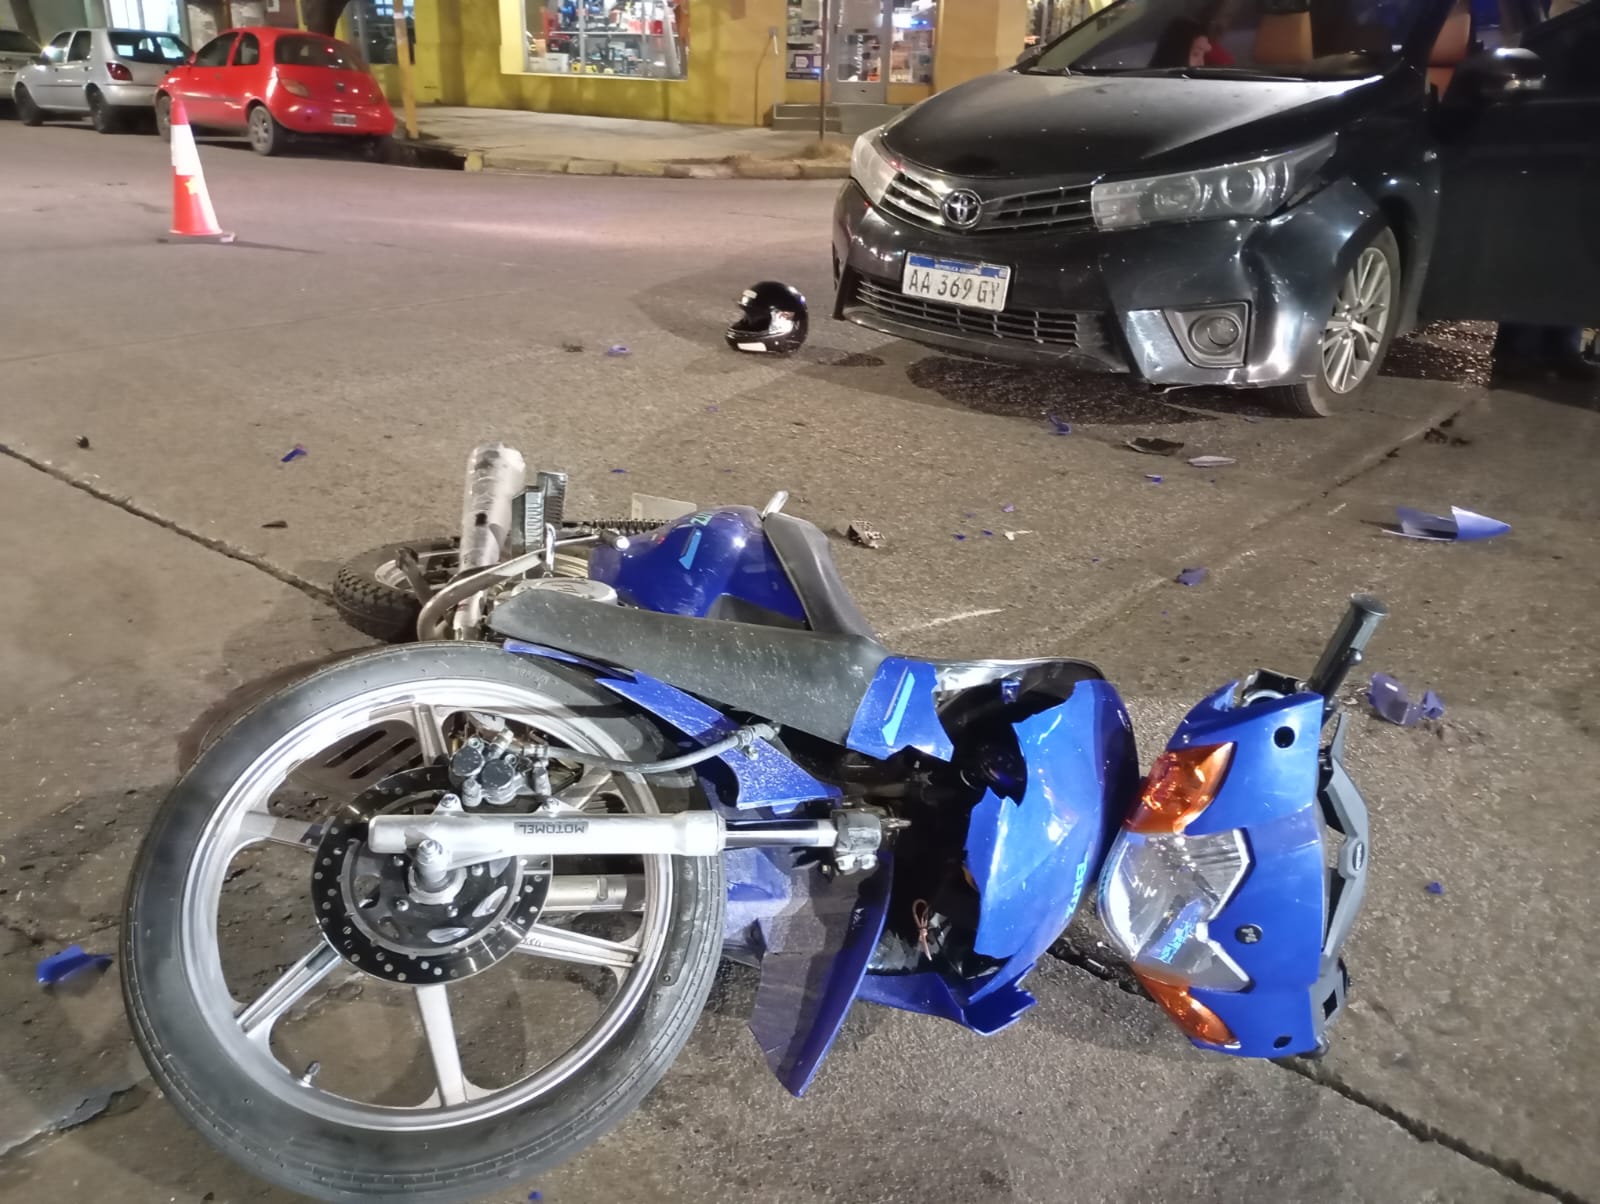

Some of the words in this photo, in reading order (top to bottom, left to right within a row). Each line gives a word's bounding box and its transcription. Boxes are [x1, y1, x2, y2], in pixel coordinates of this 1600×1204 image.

[908, 269, 930, 294] AA
[937, 275, 973, 300] 369
[977, 280, 1000, 304] GY
[519, 824, 585, 834] MOTOMEL
